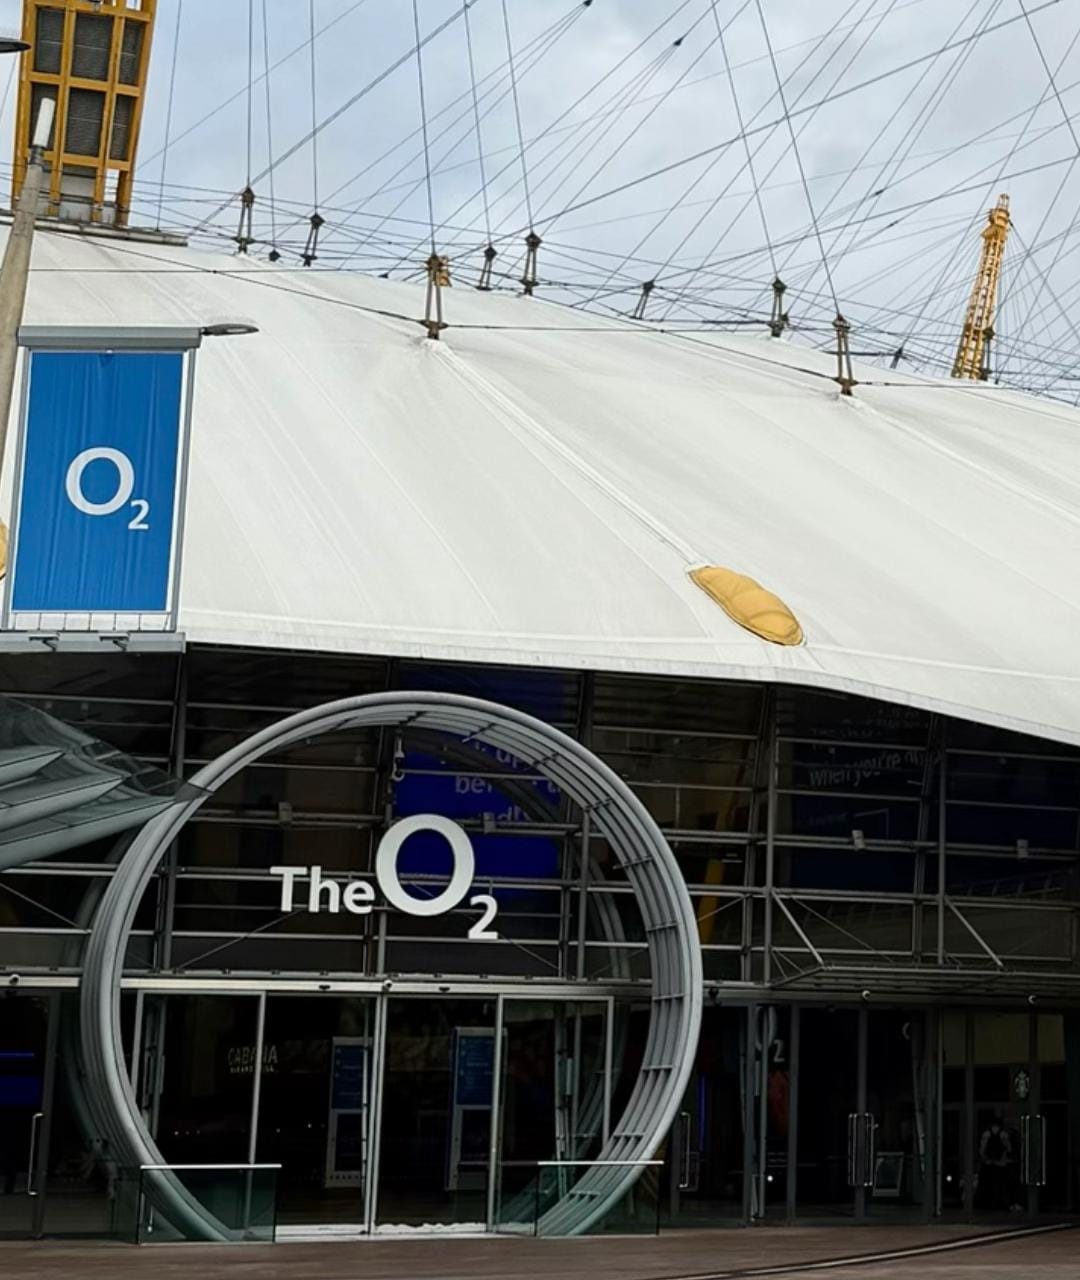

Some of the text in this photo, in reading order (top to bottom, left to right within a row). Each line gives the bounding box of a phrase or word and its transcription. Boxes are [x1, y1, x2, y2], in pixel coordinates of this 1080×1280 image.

[65, 446, 150, 530] O2
[270, 813, 499, 939] The O2
